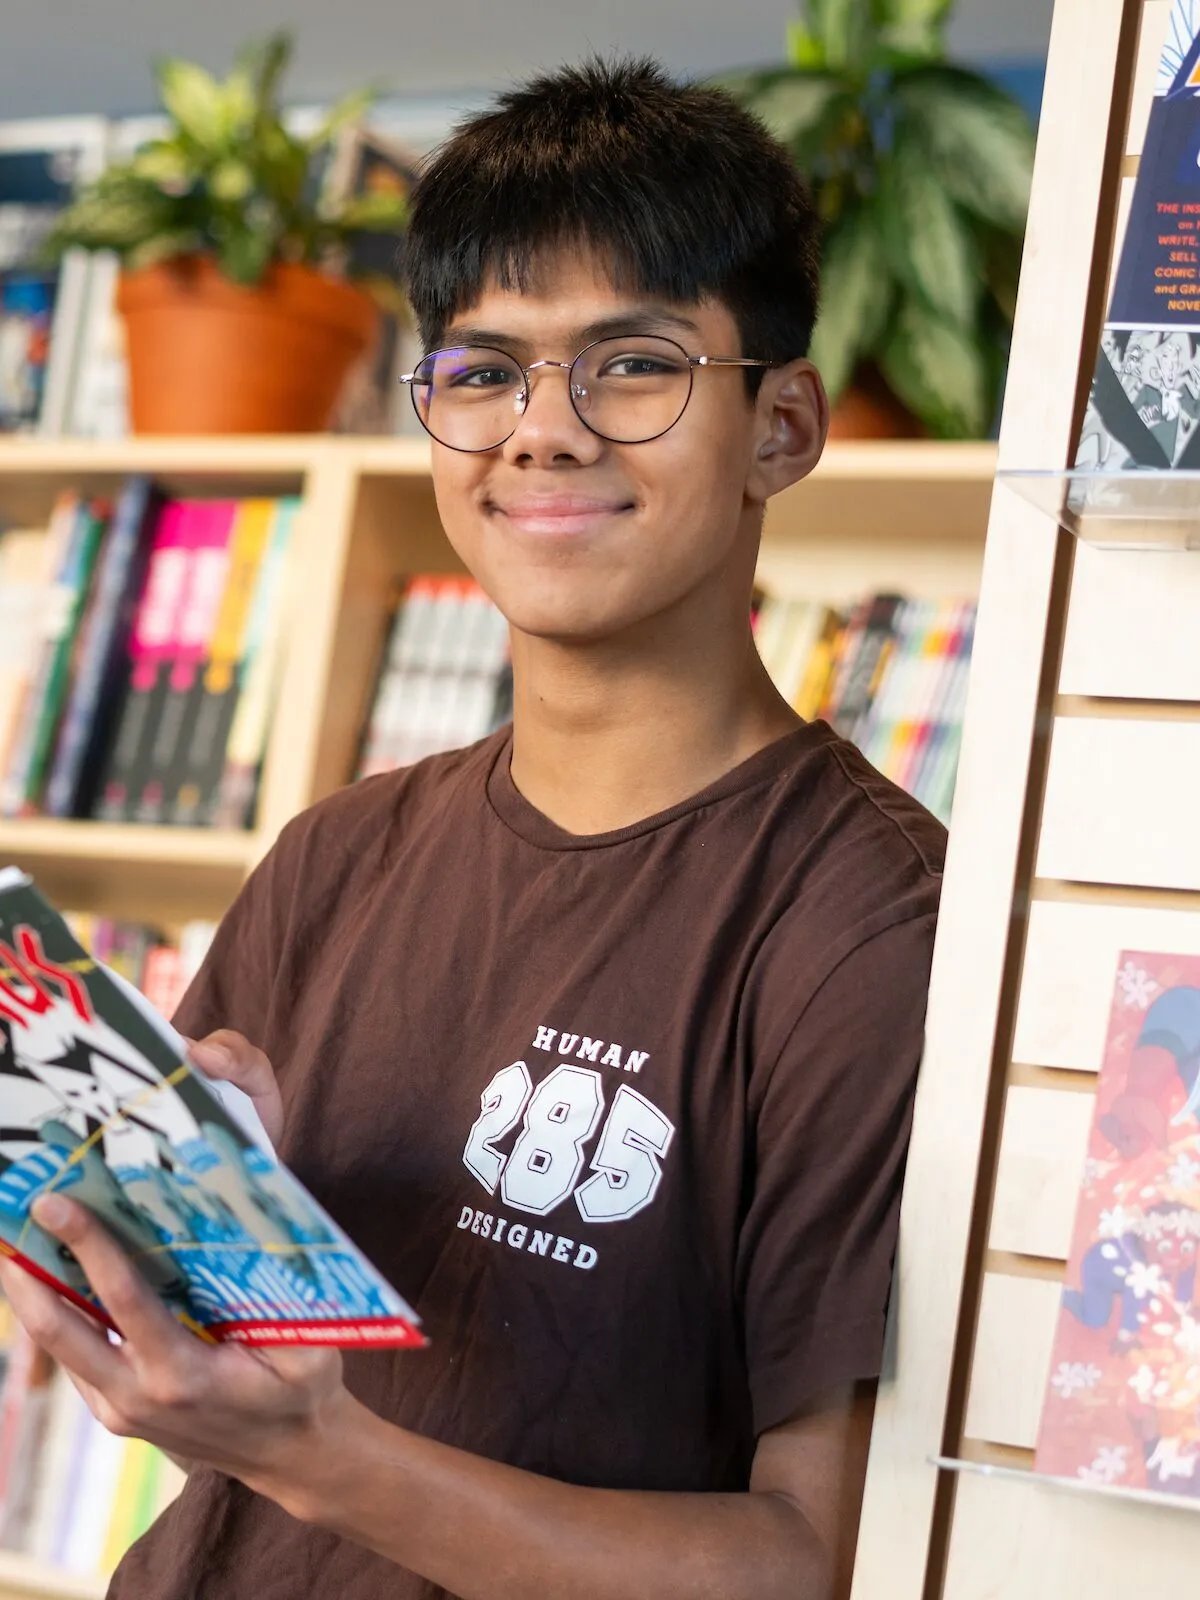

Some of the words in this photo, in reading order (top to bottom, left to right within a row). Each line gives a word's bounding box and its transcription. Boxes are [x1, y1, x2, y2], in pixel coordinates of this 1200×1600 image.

[1156, 202, 1179, 214] THE
[1177, 221, 1194, 230] on
[1169, 251, 1198, 262] SELL
[1154, 266, 1196, 278] COMIC
[1154, 284, 1177, 294] and
[532, 1025, 650, 1073] HUMAN
[462, 1060, 675, 1222] 285
[456, 1206, 598, 1270] DESIGNED
